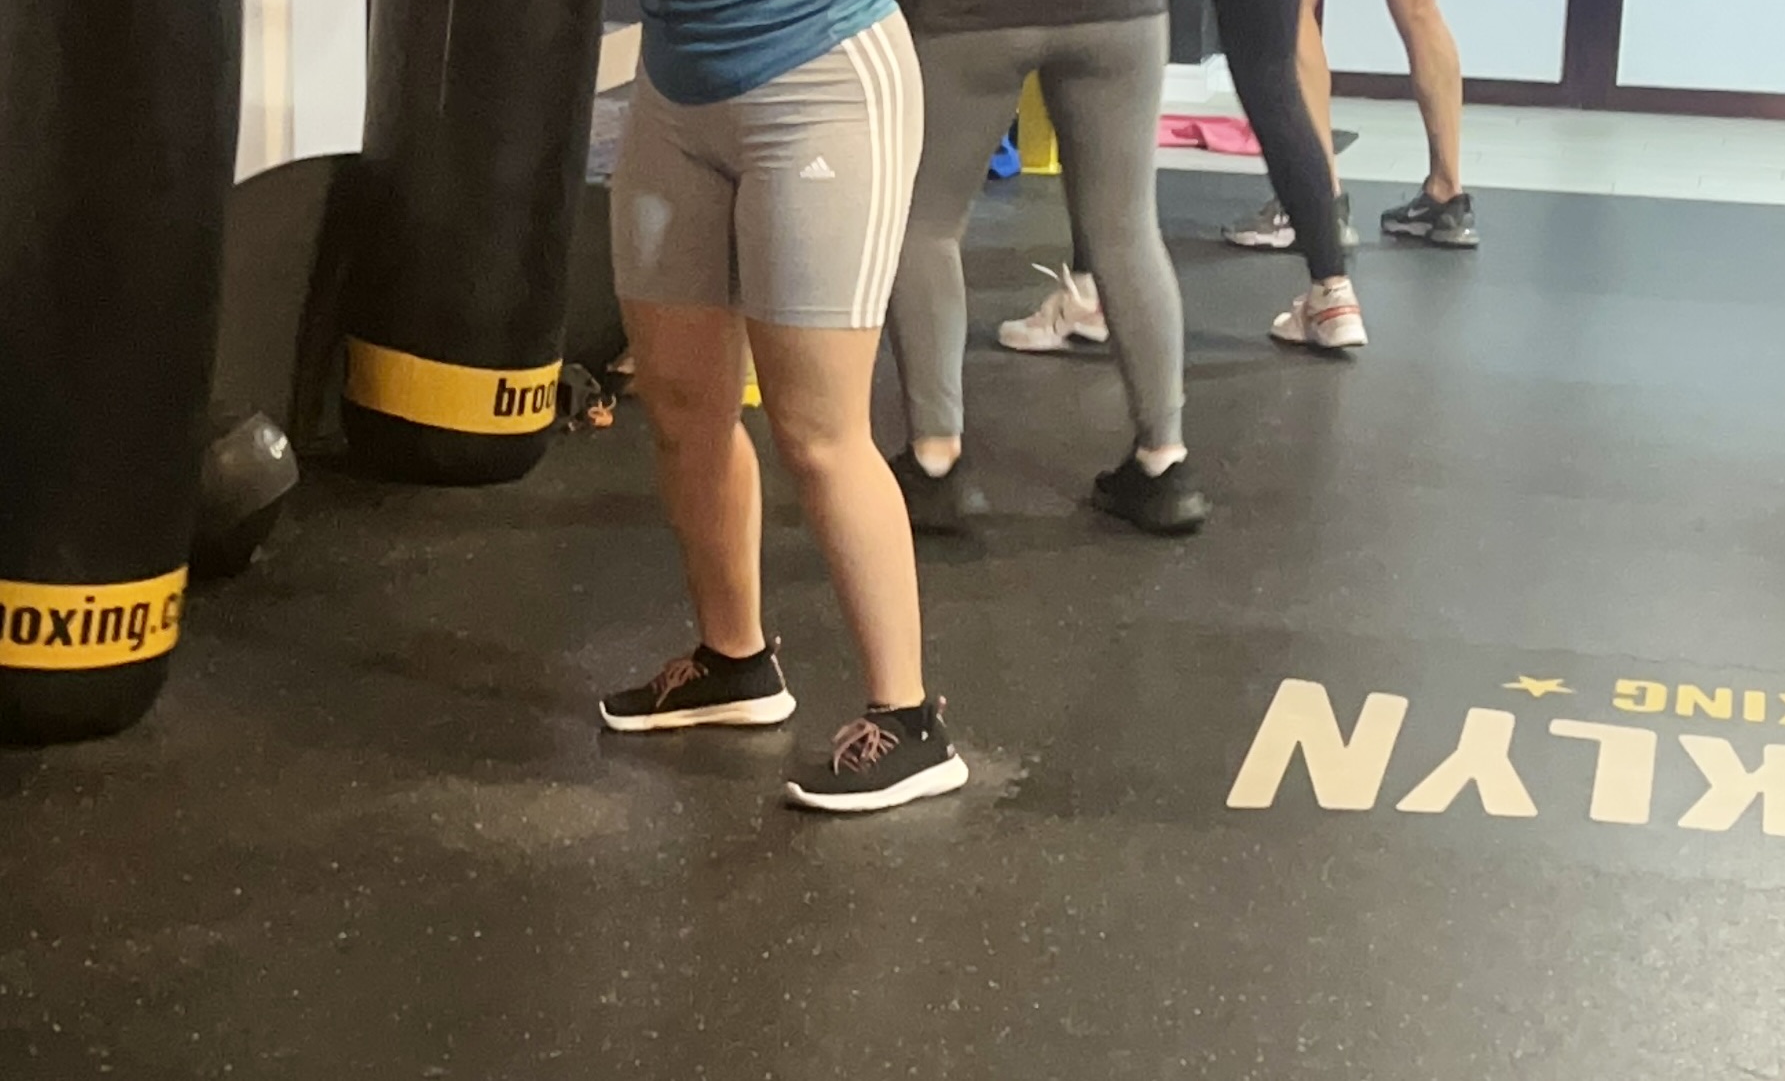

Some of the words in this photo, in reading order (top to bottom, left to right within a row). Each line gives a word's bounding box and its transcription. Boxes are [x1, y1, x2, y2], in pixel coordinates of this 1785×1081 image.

[0, 592, 180, 652] oxing.c
[1612, 678, 1785, 725] ING
[1226, 678, 1785, 837] KLYN
